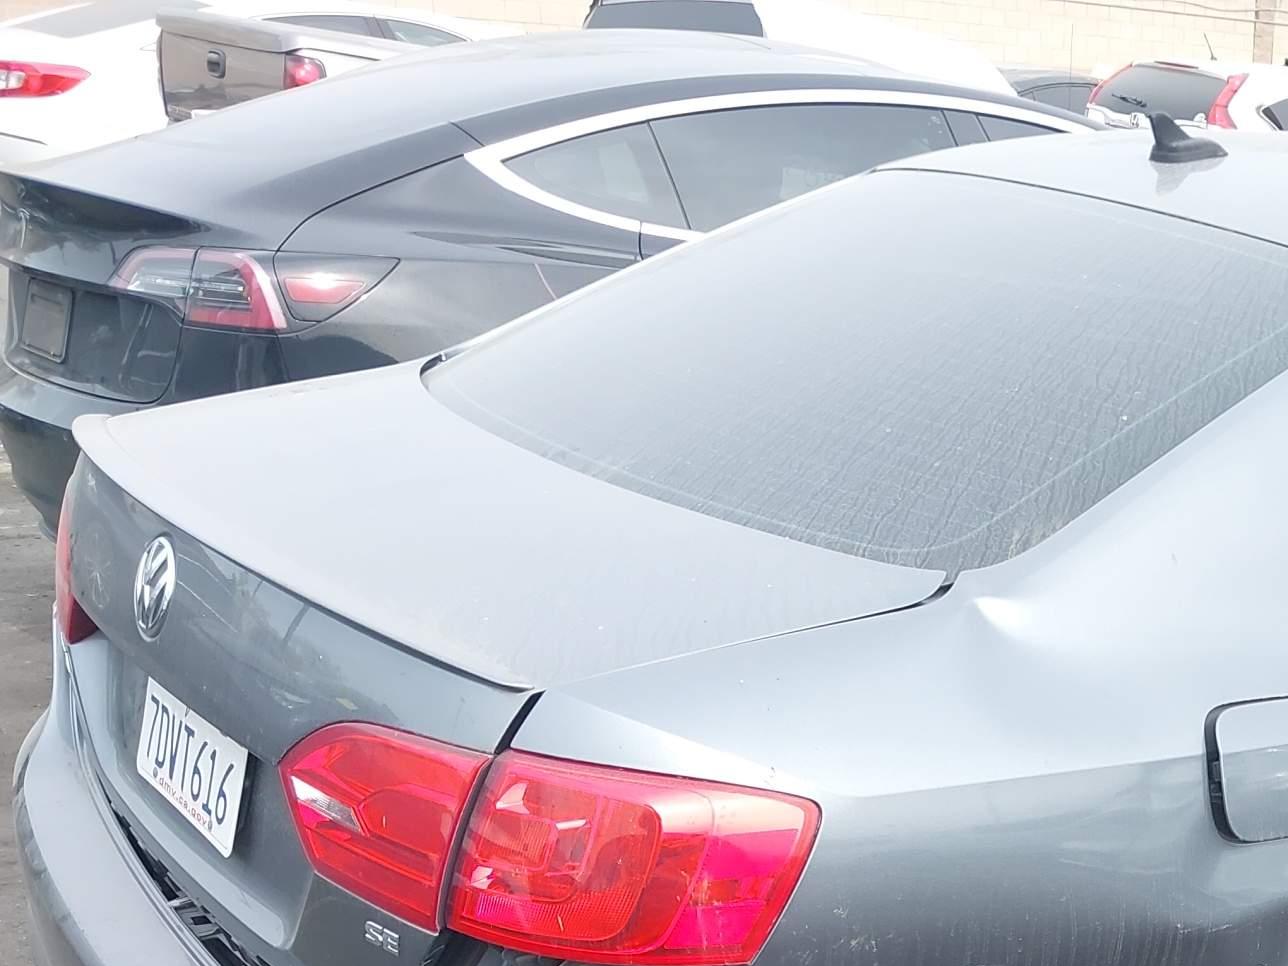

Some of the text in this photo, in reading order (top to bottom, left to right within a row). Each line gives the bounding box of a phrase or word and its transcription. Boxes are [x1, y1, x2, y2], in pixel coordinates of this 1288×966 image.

[146, 694, 235, 826] 7DVT616
[159, 776, 207, 827] dmv.ca.gov
[364, 920, 400, 957] SE
